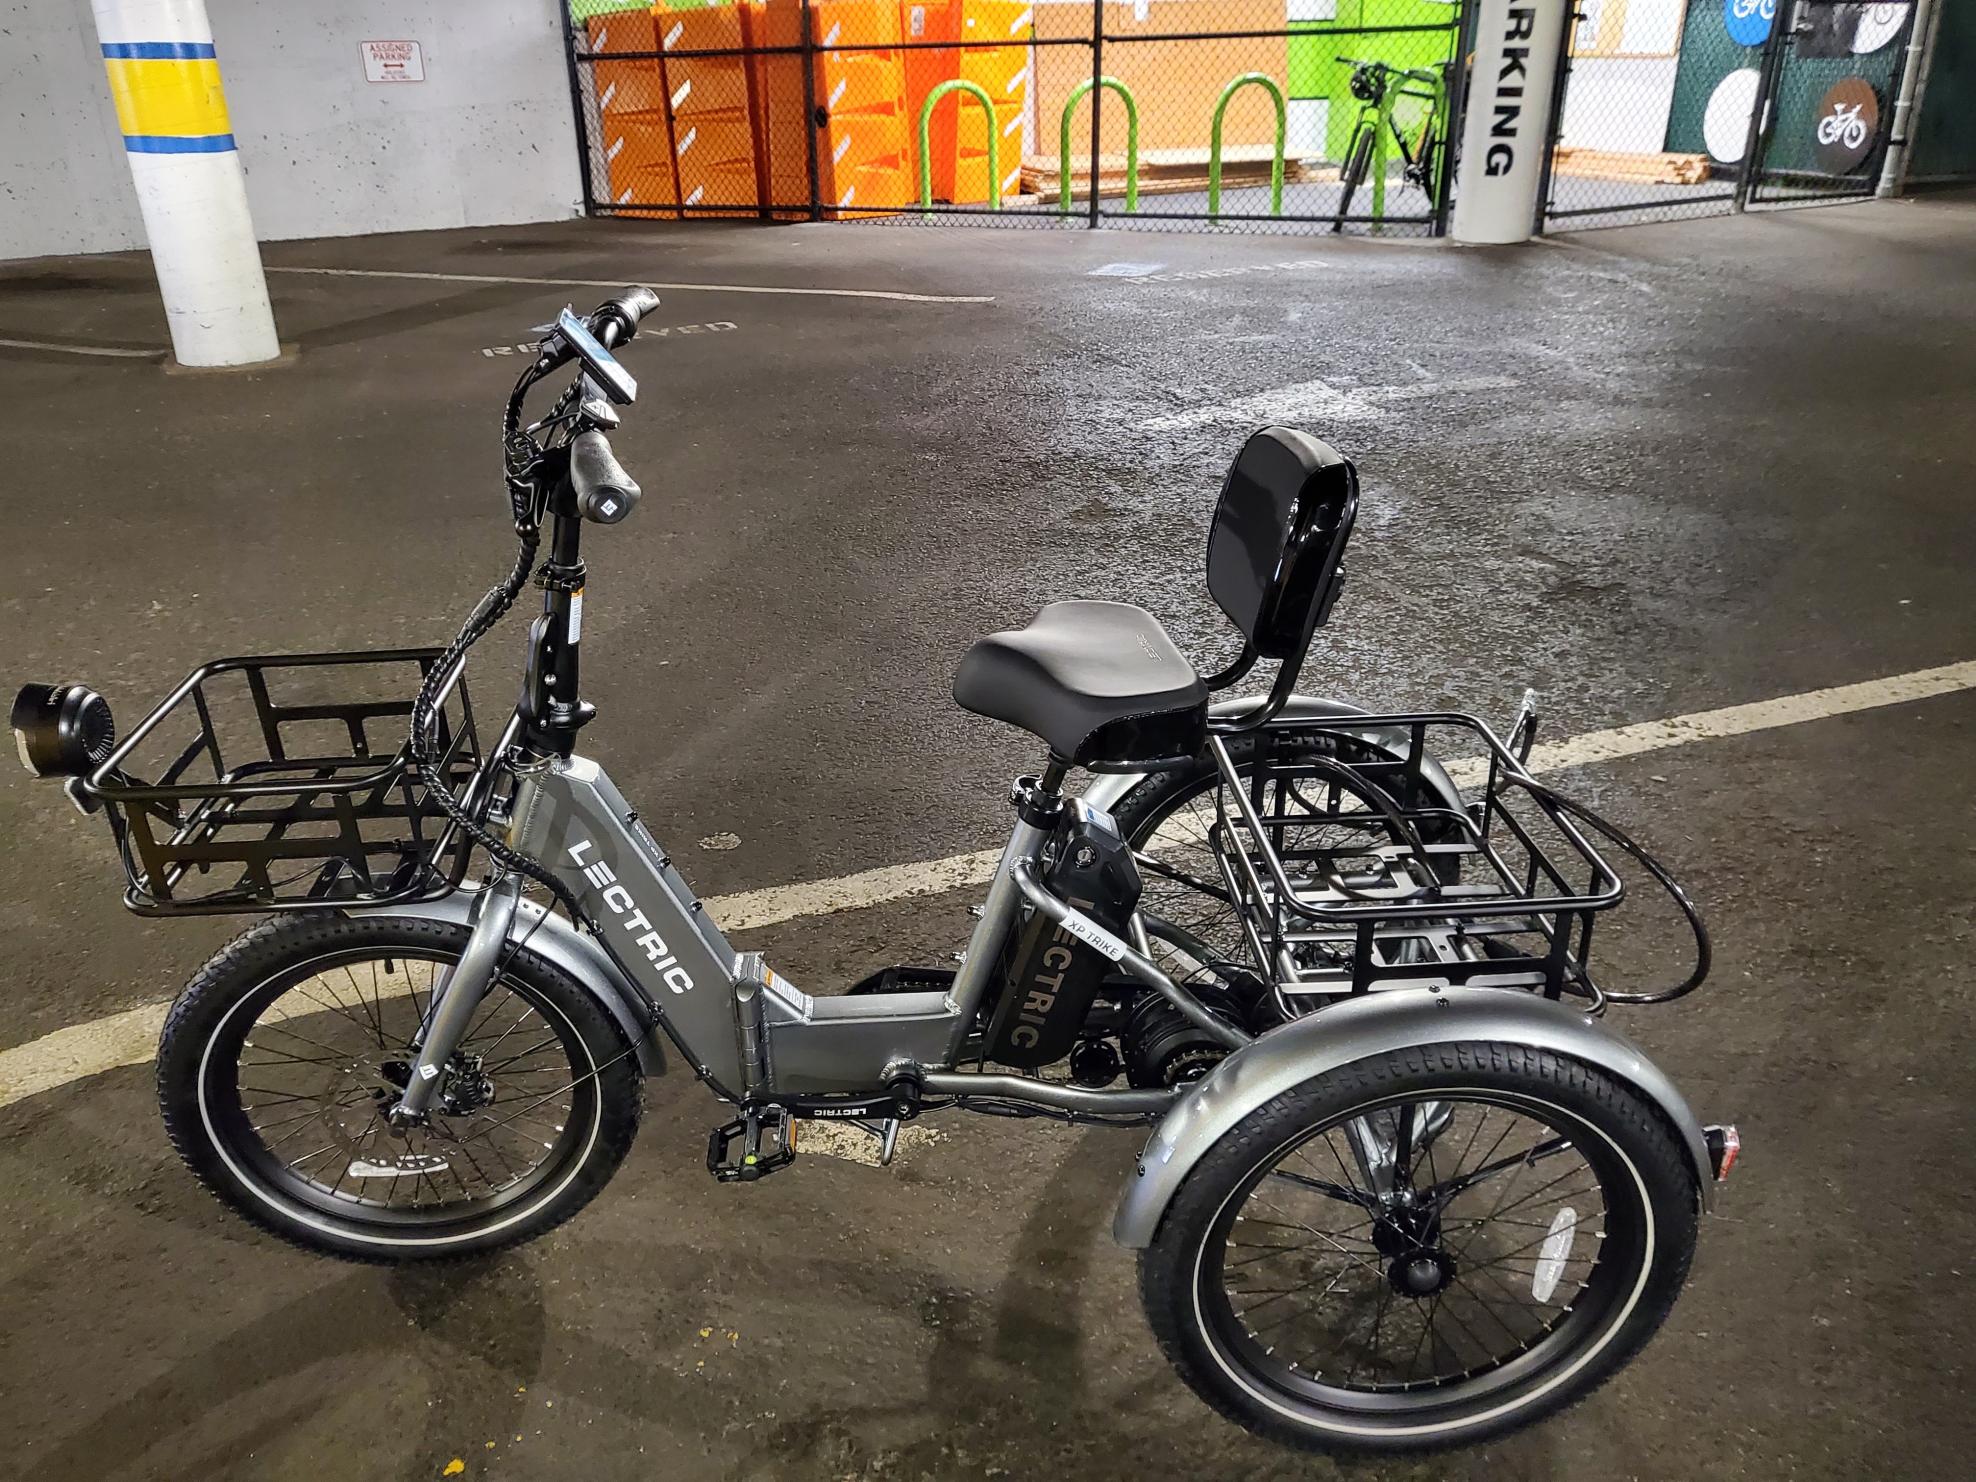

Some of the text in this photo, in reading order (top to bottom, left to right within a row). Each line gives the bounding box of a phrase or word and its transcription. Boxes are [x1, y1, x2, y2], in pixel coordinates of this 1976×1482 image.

[370, 43, 413, 52] ASSIGNED
[373, 52, 412, 61] PARKING
[1485, 0, 1536, 176] RKING
[482, 321, 738, 358] REVED
[567, 839, 695, 995] LECTRIC
[1068, 920, 1119, 957] XP TRIKE
[814, 1107, 867, 1117] LECTRIC
